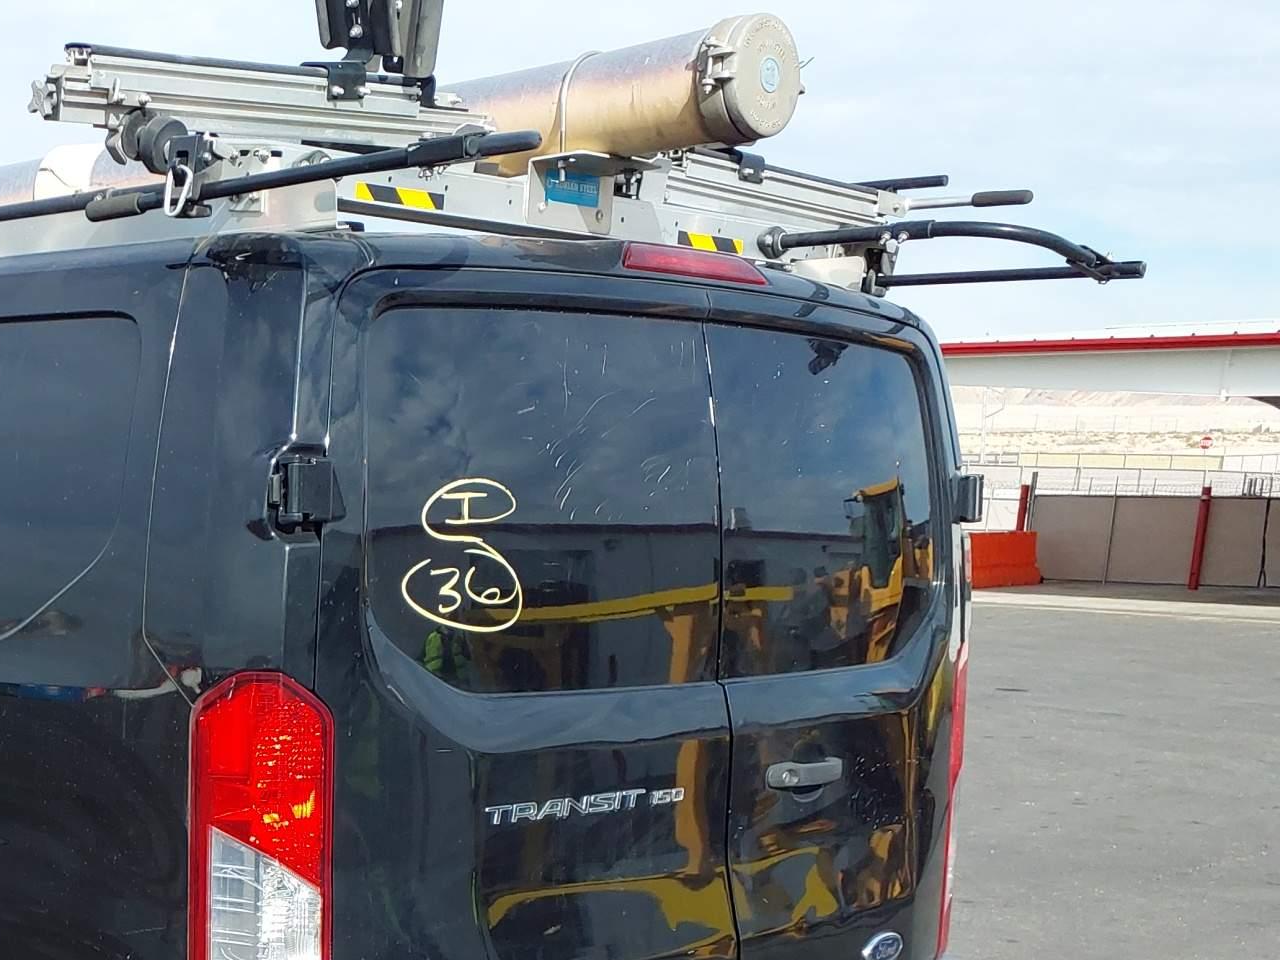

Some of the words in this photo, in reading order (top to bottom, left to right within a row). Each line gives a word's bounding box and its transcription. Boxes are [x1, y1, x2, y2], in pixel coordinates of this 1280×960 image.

[430, 566, 507, 613] 36
[485, 789, 646, 824] TRANSIT
[650, 788, 685, 807] 150
